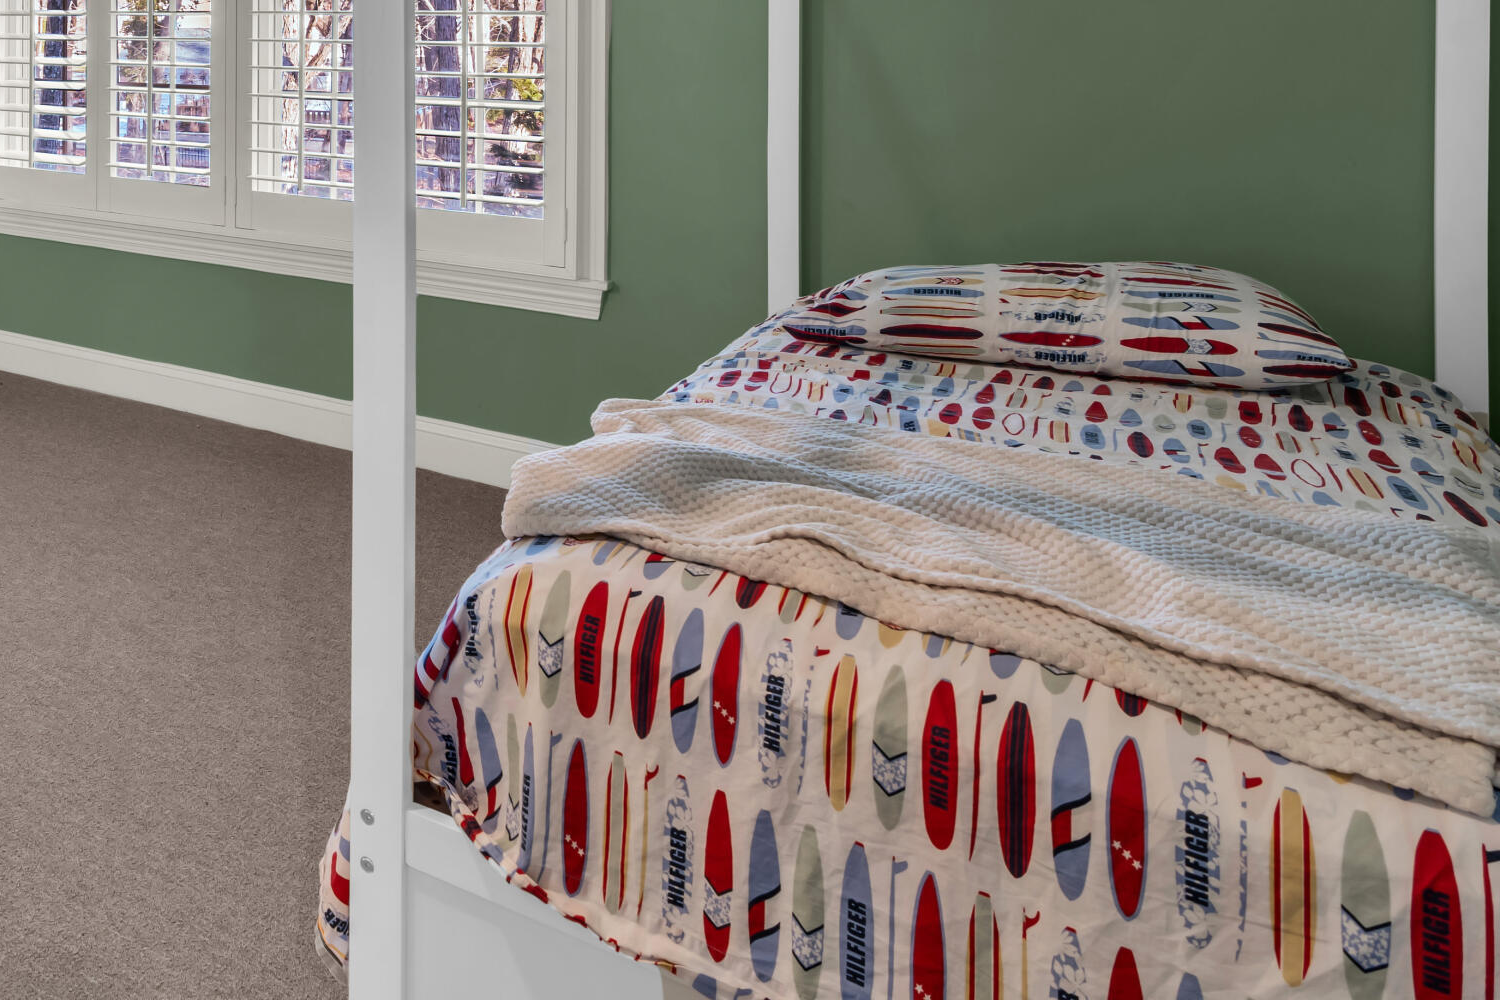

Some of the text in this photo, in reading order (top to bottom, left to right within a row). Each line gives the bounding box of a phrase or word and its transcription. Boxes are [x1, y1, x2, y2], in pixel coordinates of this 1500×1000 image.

[579, 614, 601, 685] HILFIGER
[763, 674, 785, 752] HILFIGER
[929, 725, 951, 811] HILFIGER
[667, 826, 687, 908] HILFIGER
[1184, 809, 1210, 907] HILFIGER
[846, 898, 867, 988] HILFIGER
[1422, 887, 1452, 996] HILFIGER
